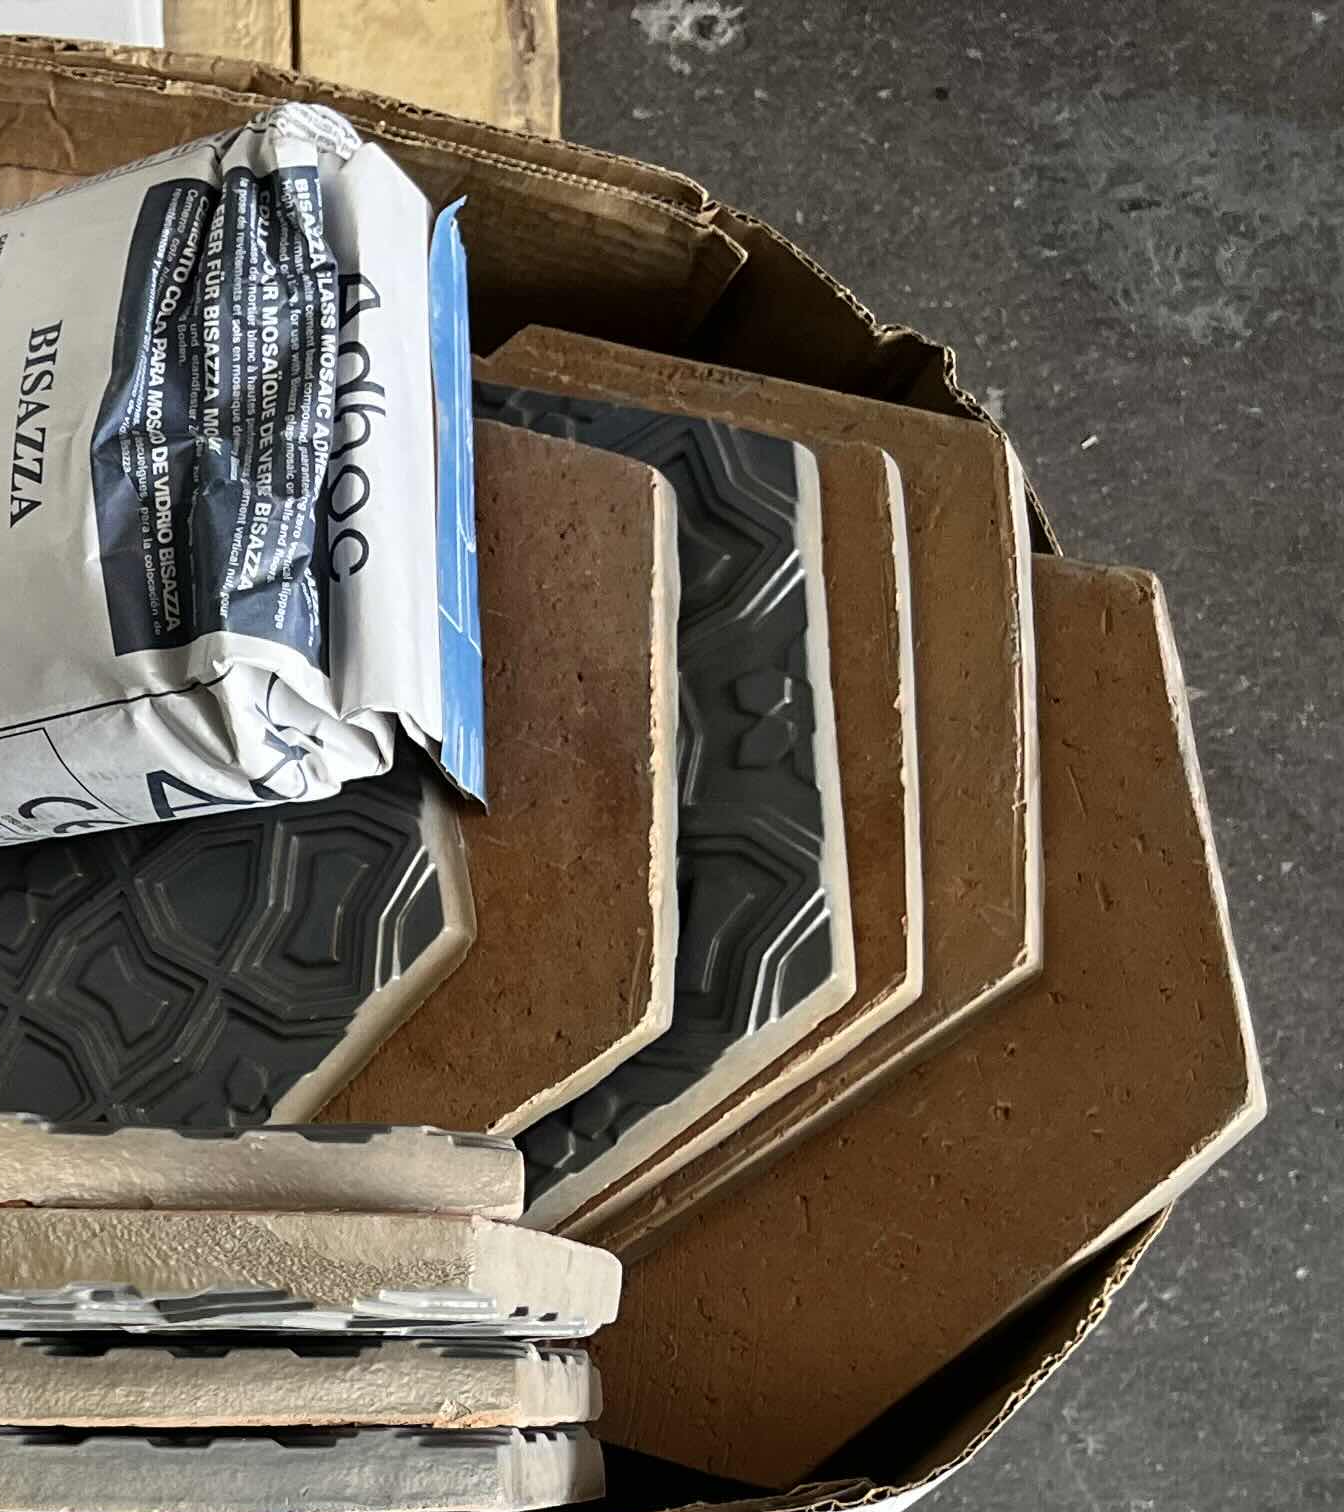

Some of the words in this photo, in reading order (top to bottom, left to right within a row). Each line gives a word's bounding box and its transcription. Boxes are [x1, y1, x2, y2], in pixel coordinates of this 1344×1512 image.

[204, 258, 224, 300] FÜR
[148, 337, 167, 386] PARA
[202, 305, 219, 402] BISAZZA
[232, 346, 240, 361] en
[246, 330, 257, 362] blanc
[259, 306, 278, 420] MOSAÏQUE
[246, 376, 256, 414] hautes
[316, 334, 335, 418] MOSAIC
[10, 320, 63, 528] BISAZZA
[258, 422, 273, 449] DE
[151, 446, 167, 475] DE
[153, 476, 172, 543] VIDRIO
[142, 538, 152, 549] la
[226, 526, 246, 566] vertical
[237, 501, 271, 591] BISAZZA
[158, 547, 180, 631] BISAZZA
[218, 592, 230, 618] pour
[272, 581, 292, 630] slippage
